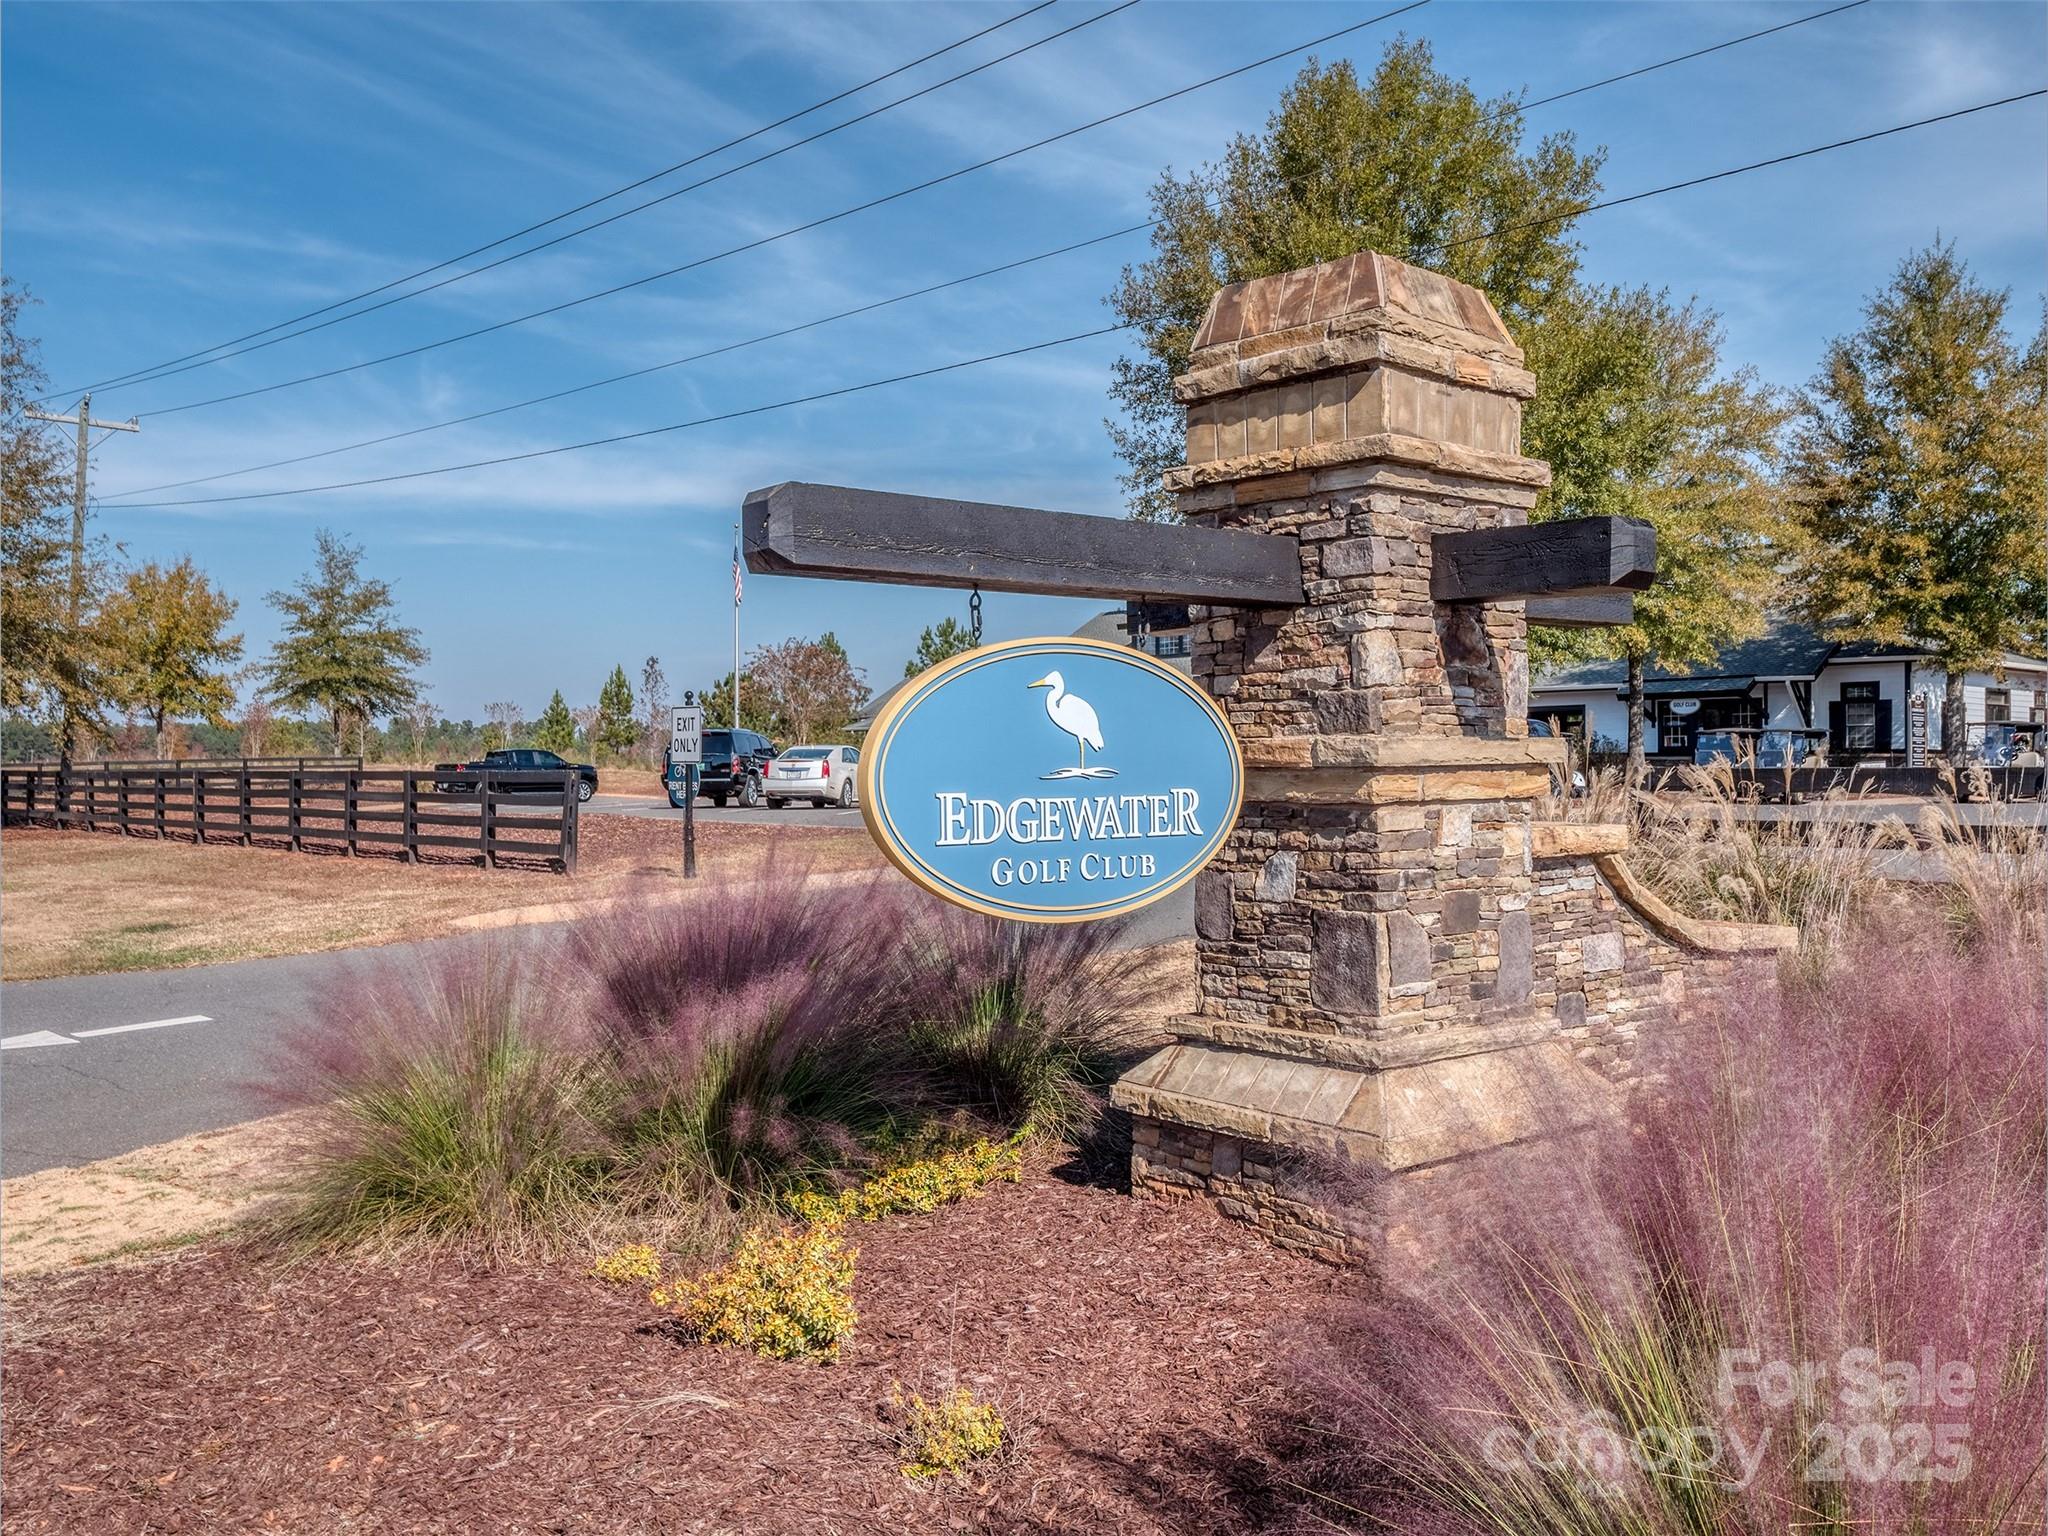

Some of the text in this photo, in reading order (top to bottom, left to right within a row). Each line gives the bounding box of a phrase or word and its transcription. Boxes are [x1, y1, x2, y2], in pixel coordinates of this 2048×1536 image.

[677, 717, 695, 732] EXIT
[674, 738, 698, 753] ONLY
[668, 781, 682, 790] RENT
[934, 787, 1204, 848] EDGEWATER
[990, 852, 1157, 887] GOLF CLUB
